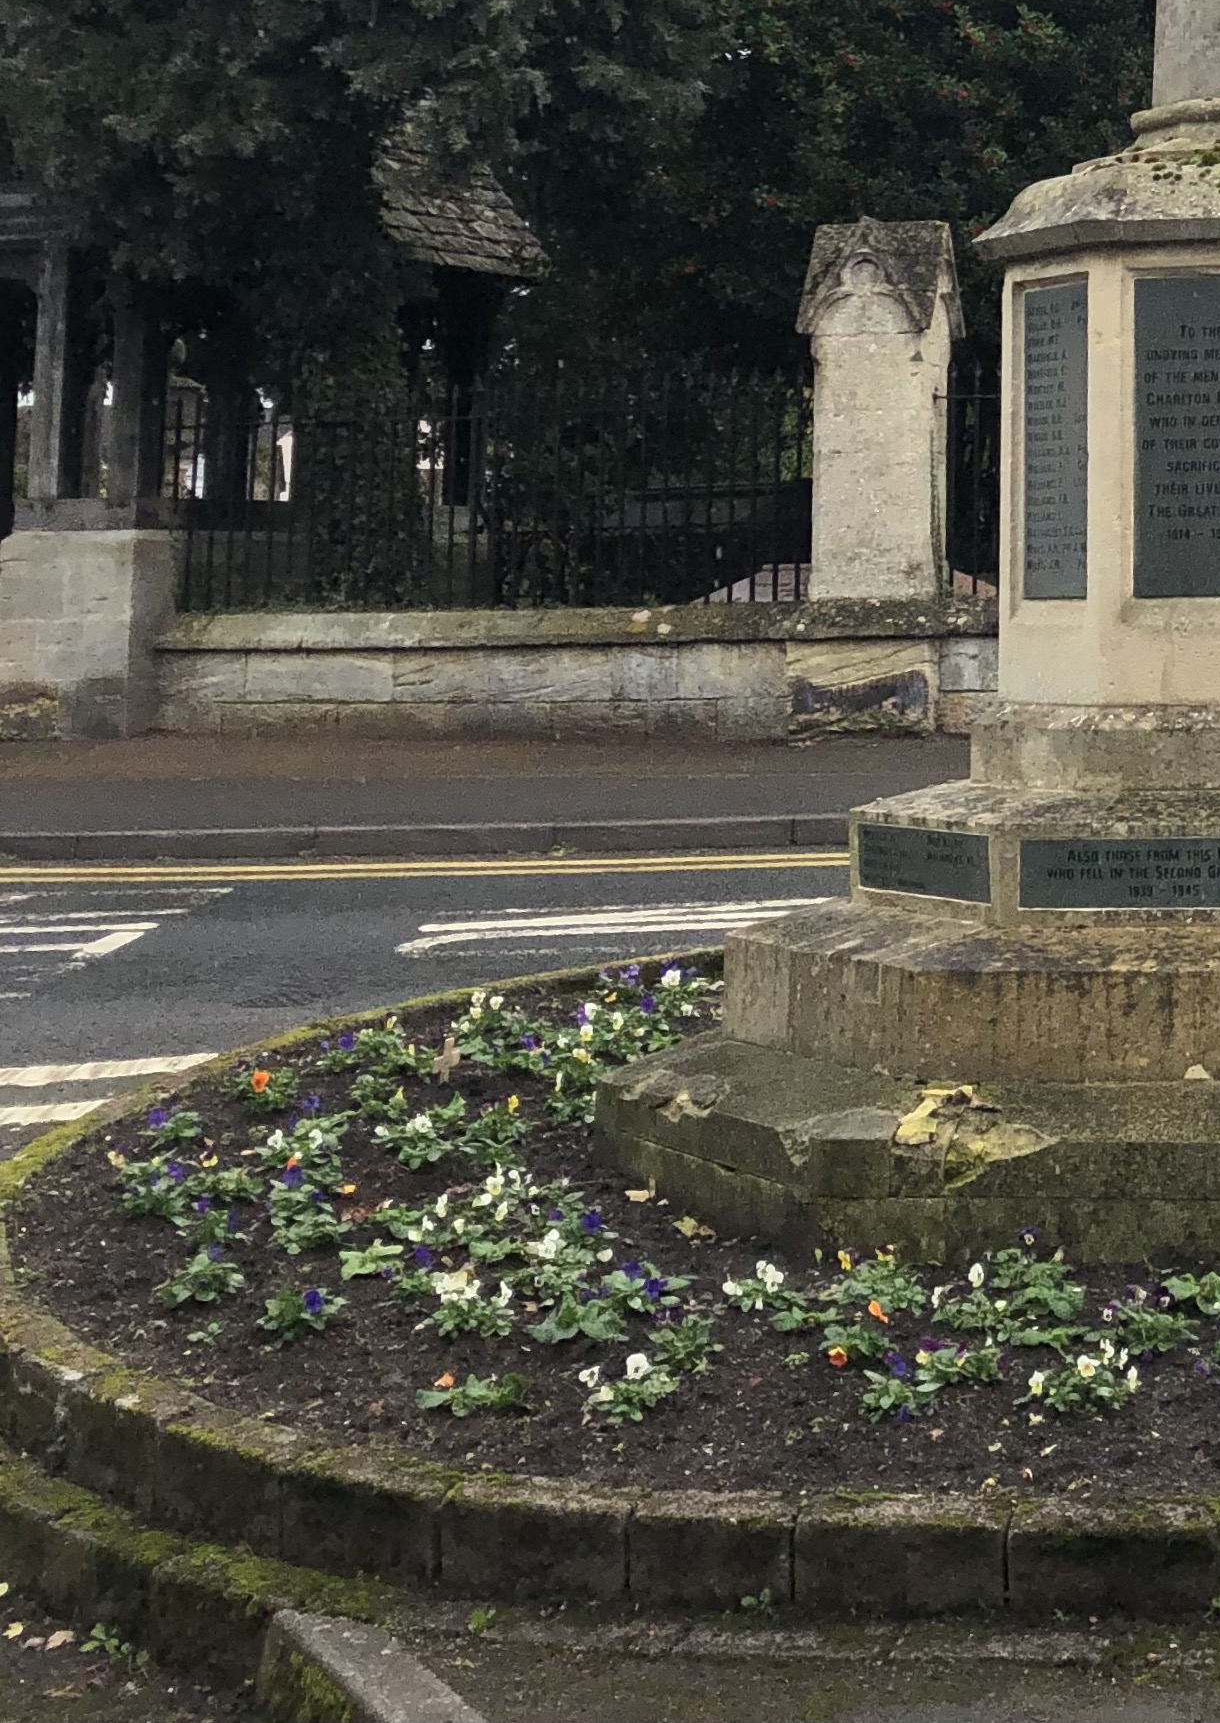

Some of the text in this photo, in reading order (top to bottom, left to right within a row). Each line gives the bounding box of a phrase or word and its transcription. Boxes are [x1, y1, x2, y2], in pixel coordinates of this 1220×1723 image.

[1179, 324, 1195, 339] TO
[1144, 349, 1198, 361] UNDYING
[1143, 371, 1158, 384] OF
[1165, 371, 1187, 384] THE
[1193, 370, 1219, 383] MEN
[1146, 392, 1211, 406] CHARLTON
[1149, 416, 1178, 429] WHO
[1183, 416, 1196, 428] IN
[1142, 439, 1157, 450] OF
[1163, 438, 1198, 451] THEIR
[1155, 482, 1189, 496] THEIR
[1147, 504, 1172, 519] THE
[1177, 503, 1218, 518] GREAT
[1166, 528, 1191, 541] 1914
[1066, 849, 1099, 863] ALSO
[1104, 849, 1142, 862] THOSE
[1146, 848, 1180, 861] FROM
[1185, 848, 1212, 862] THIS
[1046, 867, 1075, 880] WHO
[1080, 867, 1105, 880] FELL
[1109, 866, 1124, 879] IN
[1129, 866, 1150, 879] THE
[1155, 865, 1202, 880] SECOND
[1128, 884, 1154, 897] 1939
[1171, 884, 1201, 897] 1945
